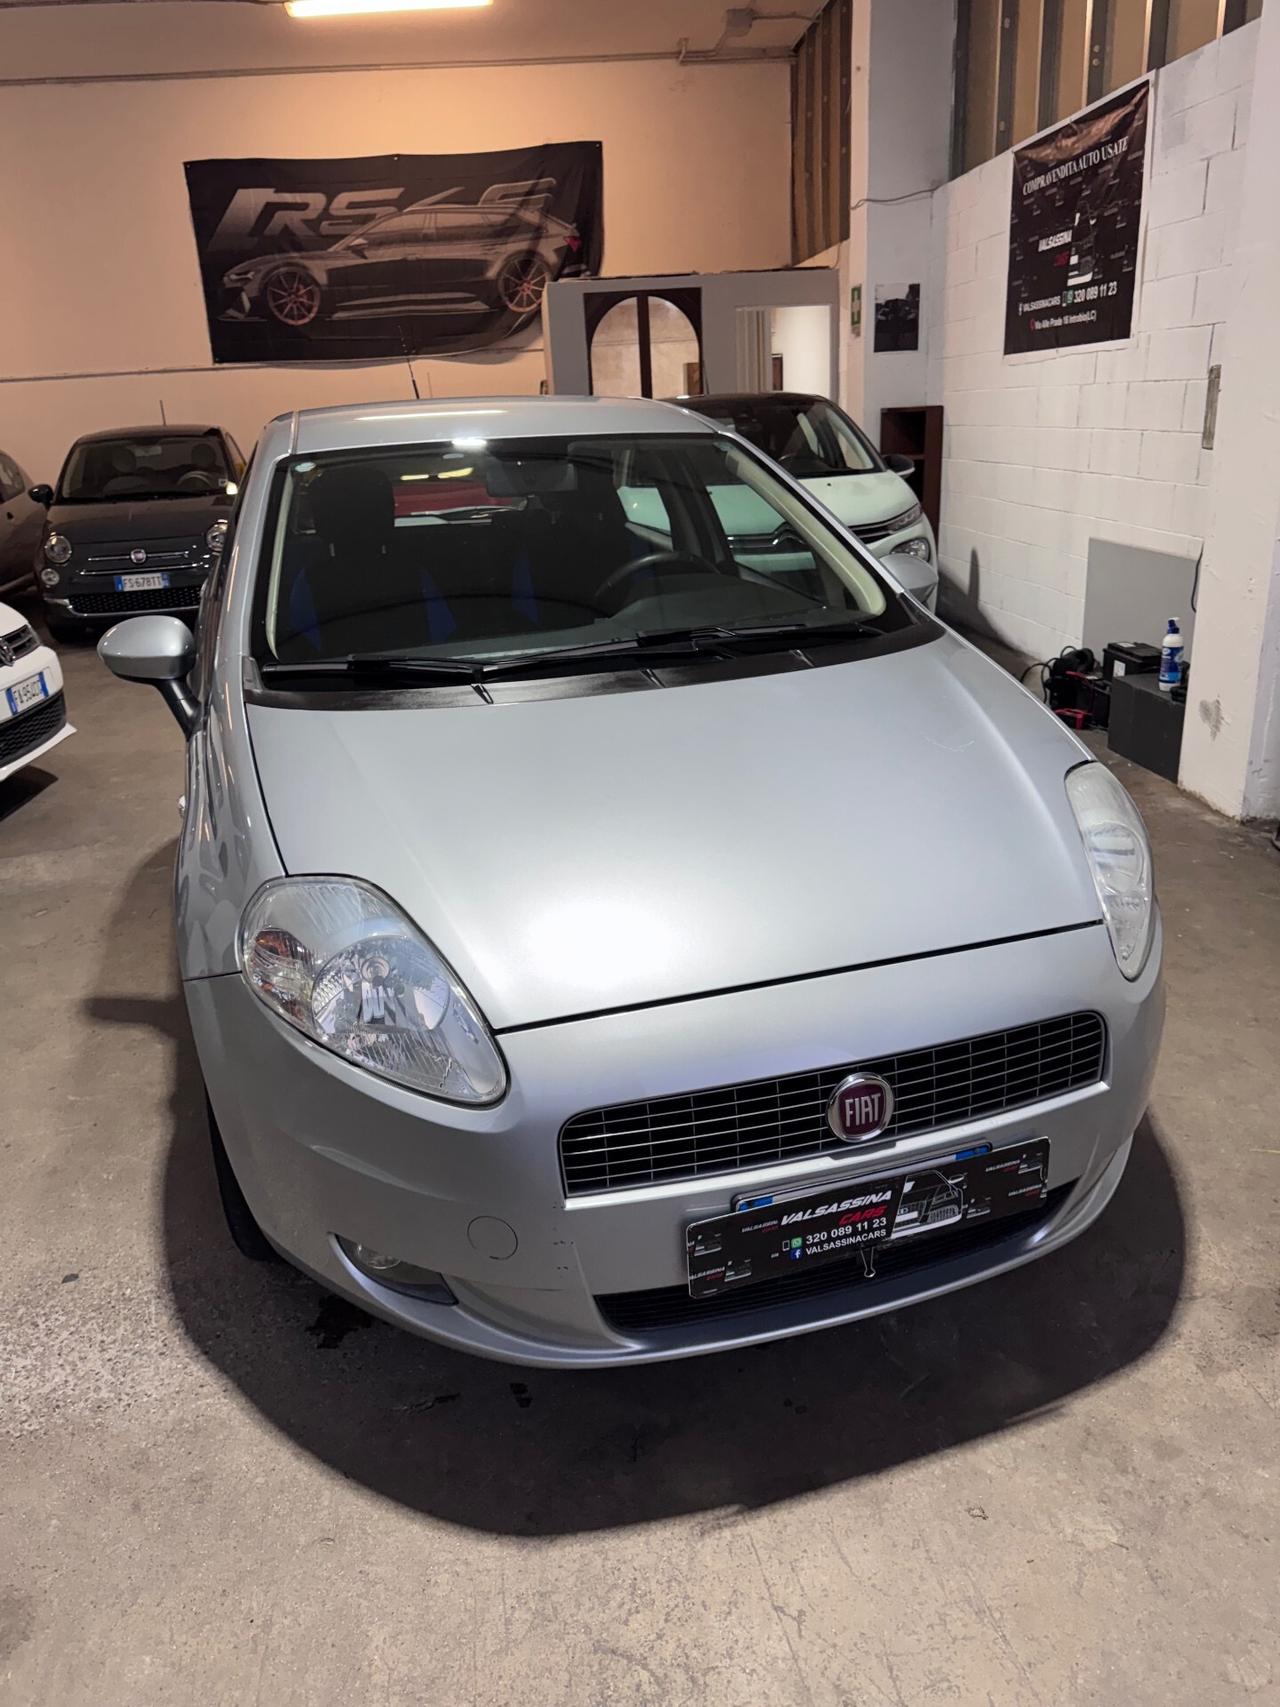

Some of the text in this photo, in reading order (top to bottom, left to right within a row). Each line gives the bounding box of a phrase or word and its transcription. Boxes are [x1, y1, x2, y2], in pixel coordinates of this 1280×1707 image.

[1022, 136, 1129, 196] COMPRAVENDITA AUTO USATE
[1108, 281, 1118, 296] 23
[845, 1093, 881, 1127] FIAT
[781, 1190, 892, 1225] VALSASSINA
[839, 1204, 888, 1226] CARS
[806, 1217, 887, 1244] 320 089 11 23
[806, 1229, 887, 1255] VALSASSINACARS
